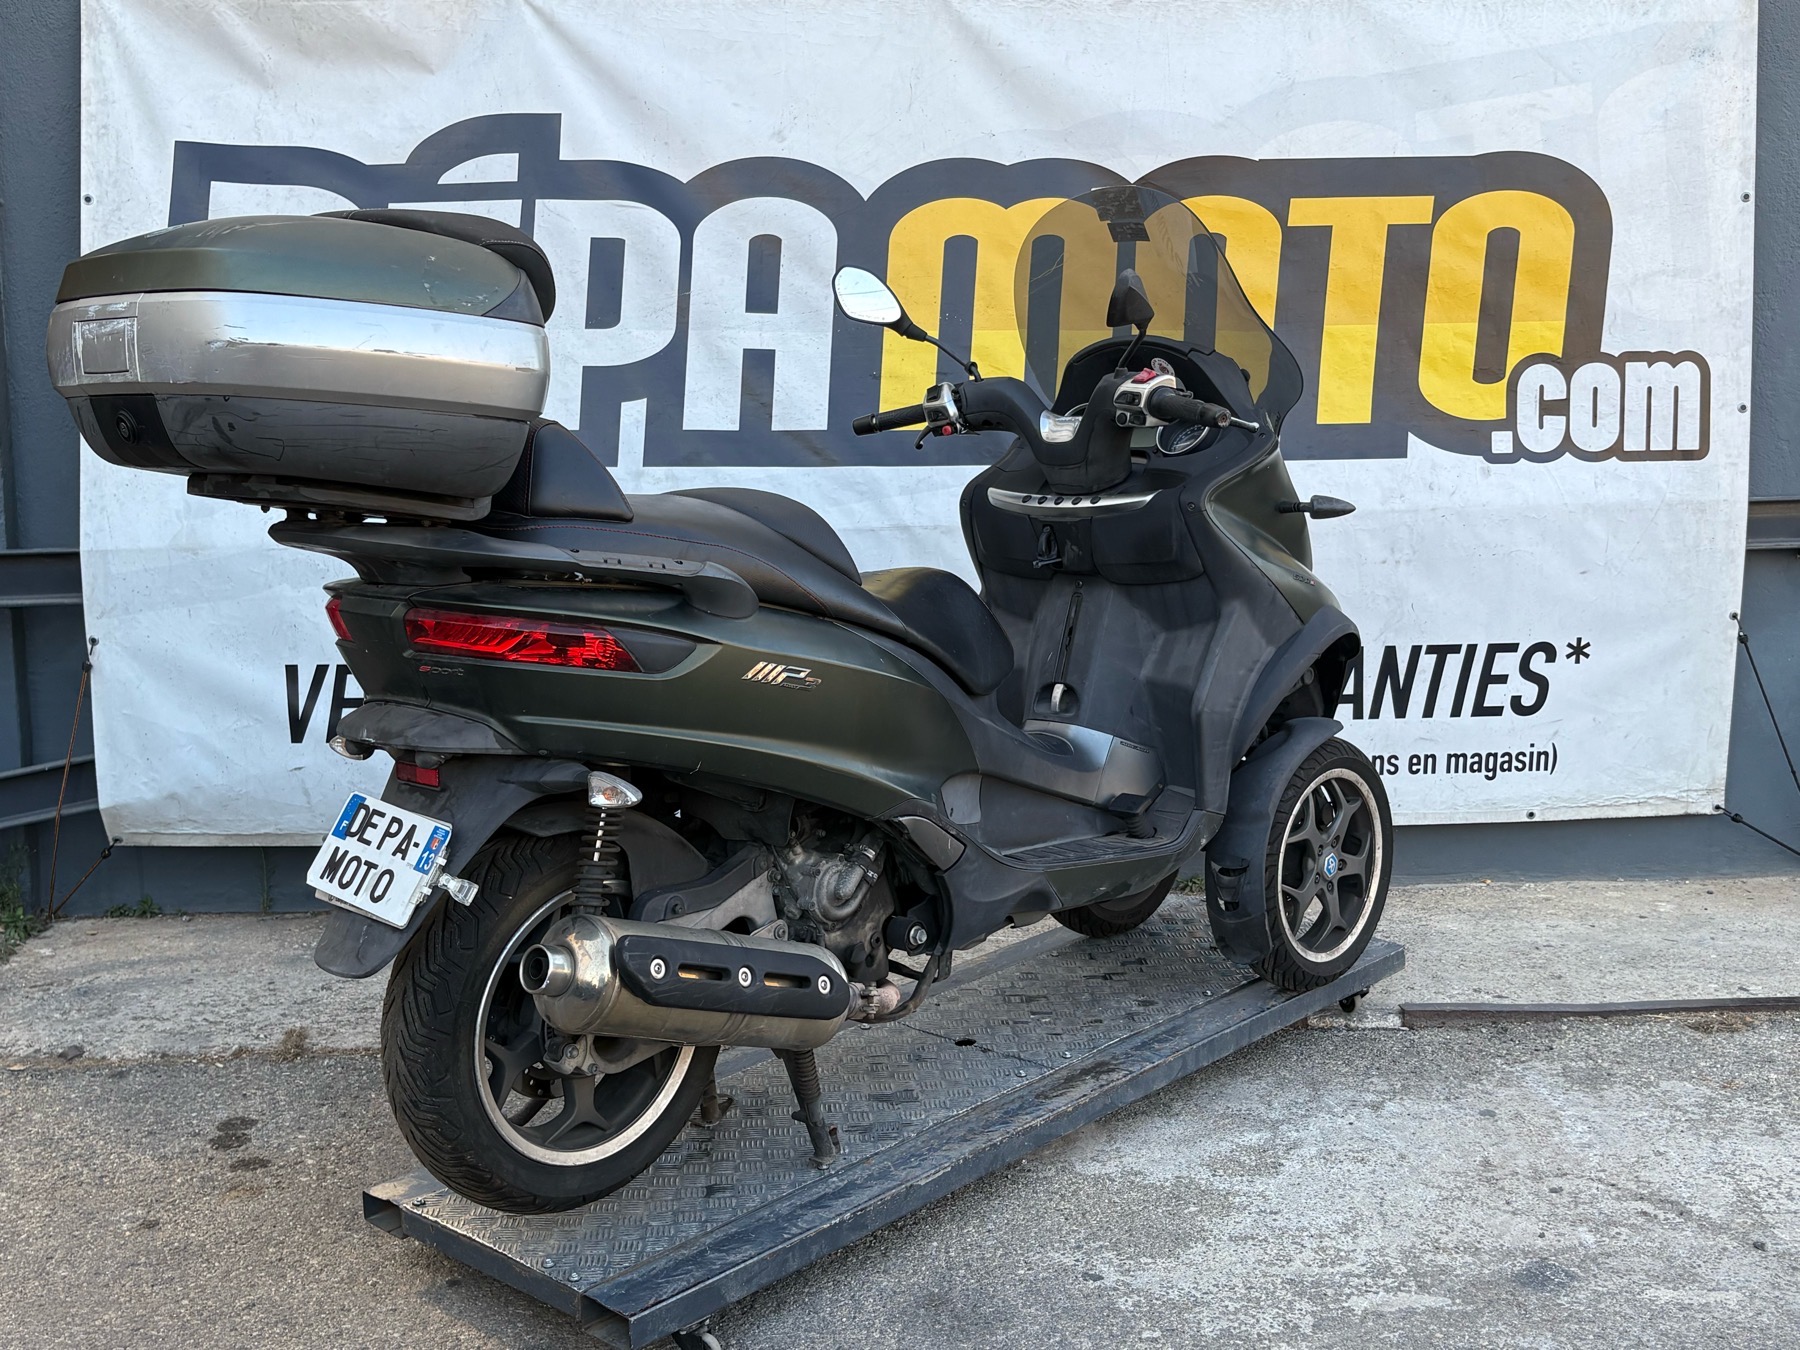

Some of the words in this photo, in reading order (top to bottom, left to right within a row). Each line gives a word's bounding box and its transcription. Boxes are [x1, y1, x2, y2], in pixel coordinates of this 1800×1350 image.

[1408, 754, 1437, 775] en
[1446, 742, 1558, 781] magasin)
[339, 819, 349, 830] F
[319, 846, 395, 904] MOTO
[419, 850, 435, 871] 13
